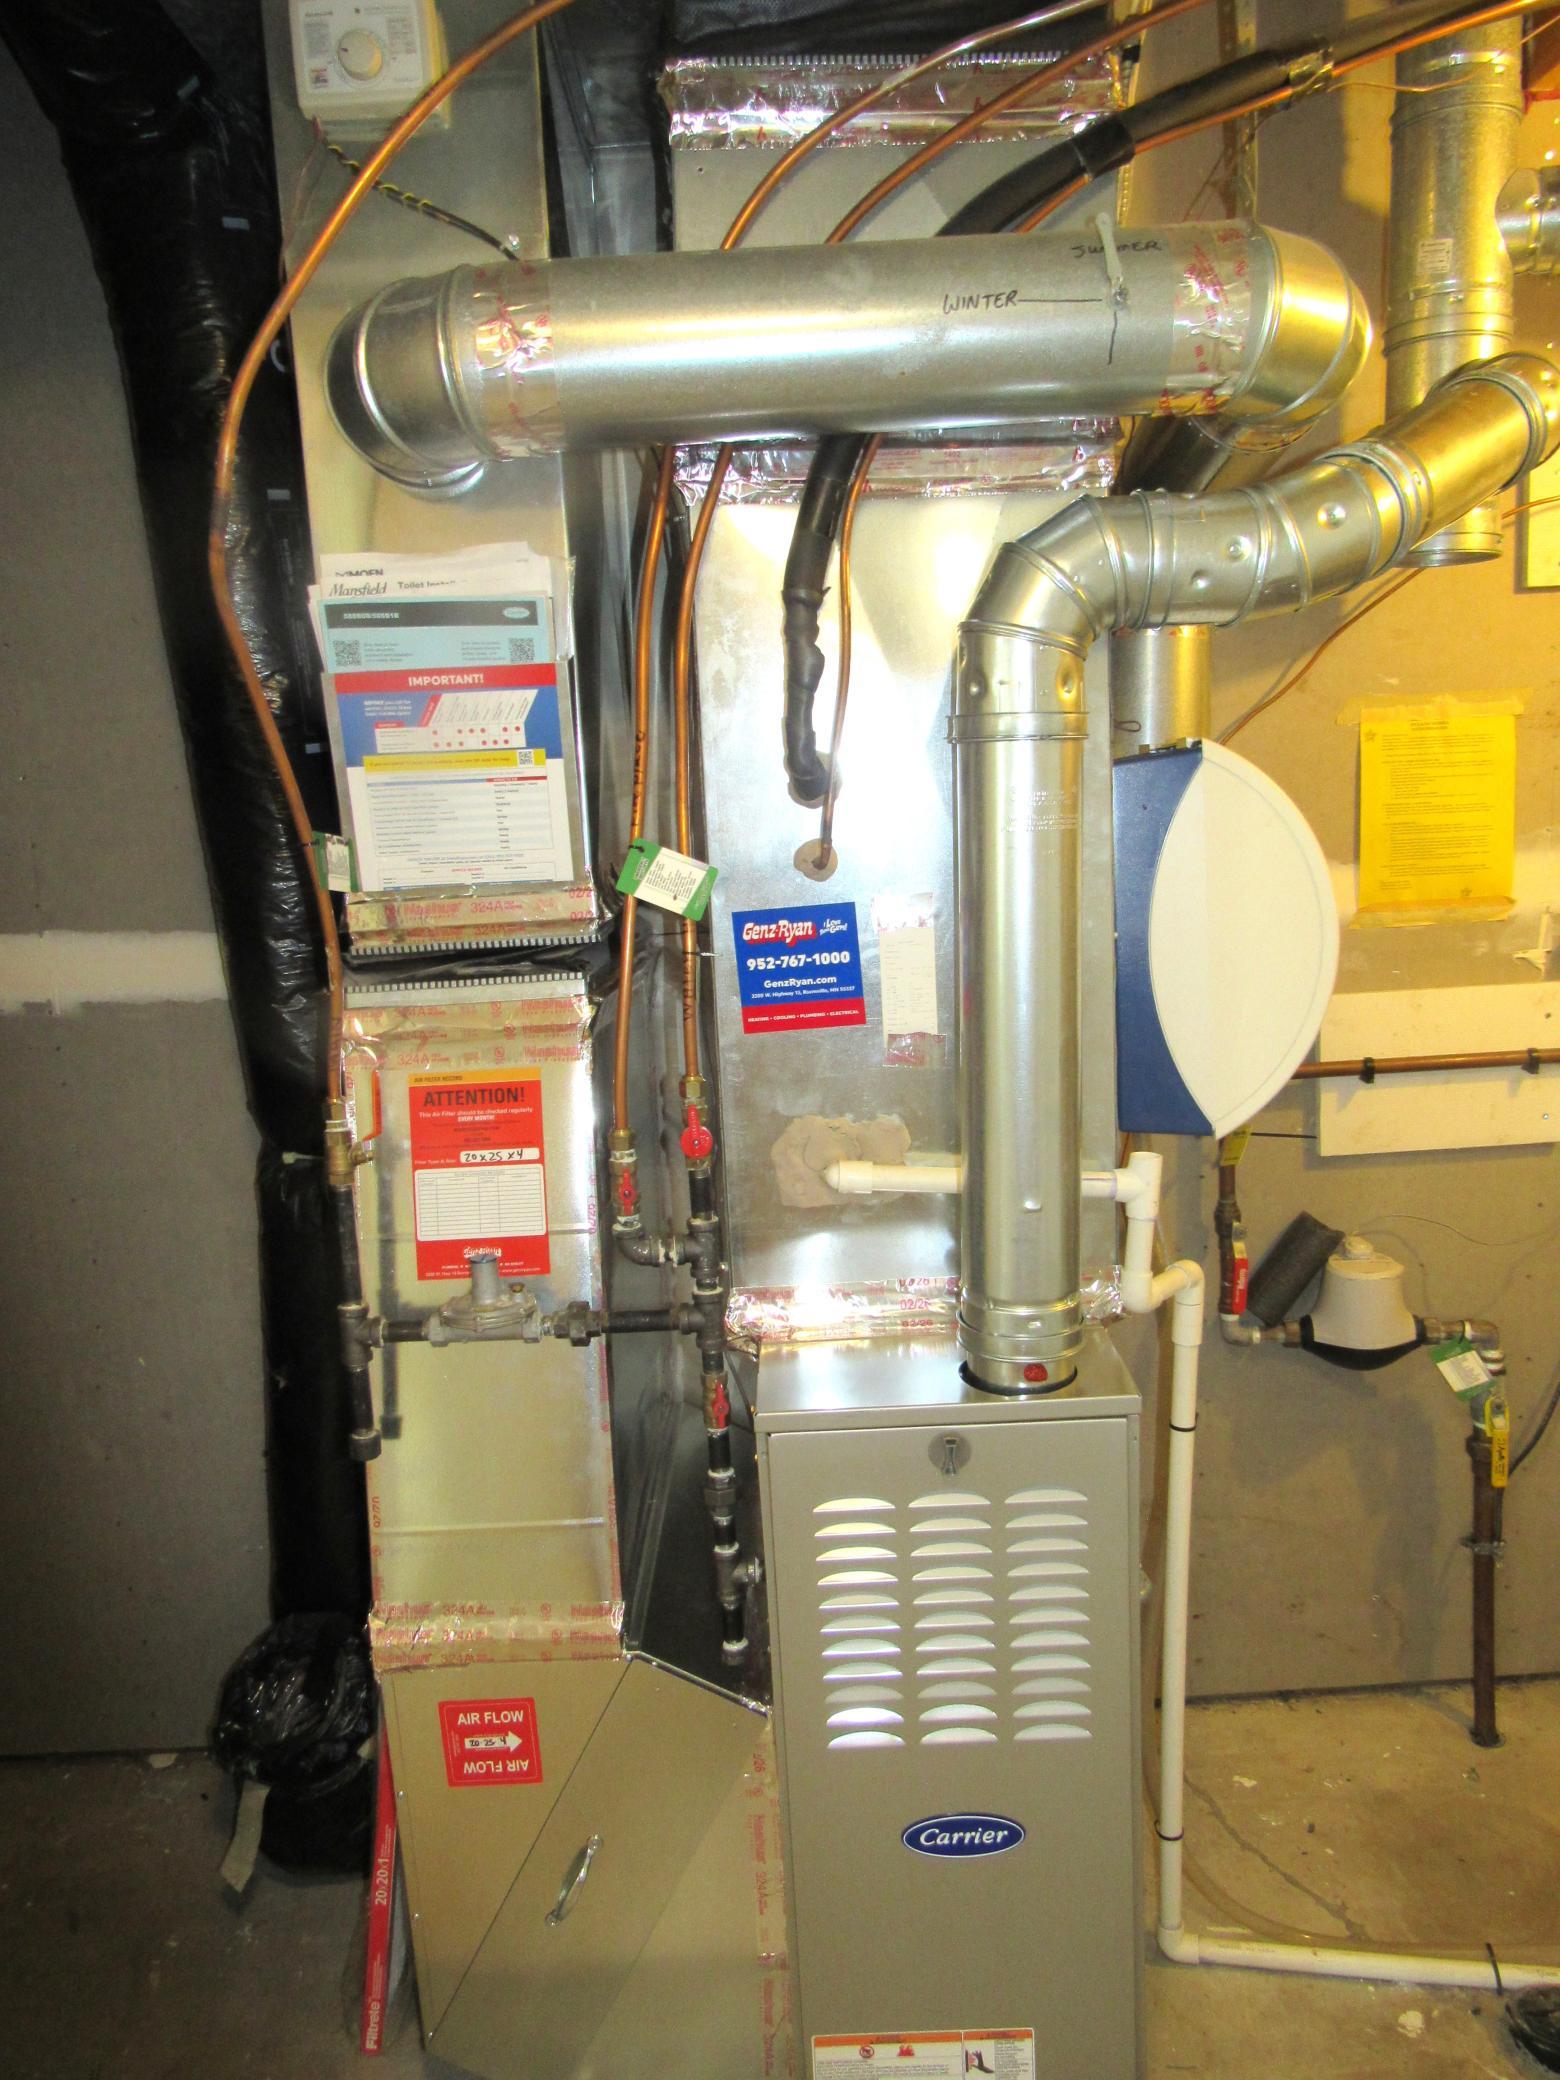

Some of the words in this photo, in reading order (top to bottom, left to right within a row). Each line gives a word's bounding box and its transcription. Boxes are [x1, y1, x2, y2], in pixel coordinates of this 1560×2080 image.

[1071, 239, 1162, 258] SUMER
[943, 289, 1018, 315] WINTER
[329, 582, 388, 597] Mansfield
[397, 581, 425, 590] Toilet
[408, 673, 485, 687] IMPORTANT!
[470, 900, 504, 914] 324A
[742, 919, 813, 944] Genz-Ryan
[746, 950, 851, 971] 952-767-1000
[763, 976, 837, 988] GenzRyan.com
[423, 1086, 525, 1107] ATTENTION!
[508, 1106, 533, 1114] regularly
[457, 1711, 480, 1726] AIR
[483, 1710, 524, 1724] FLOW
[463, 1761, 503, 1774] FLOW
[506, 1759, 530, 1772] AIR
[919, 1827, 1009, 1846] Carrier
